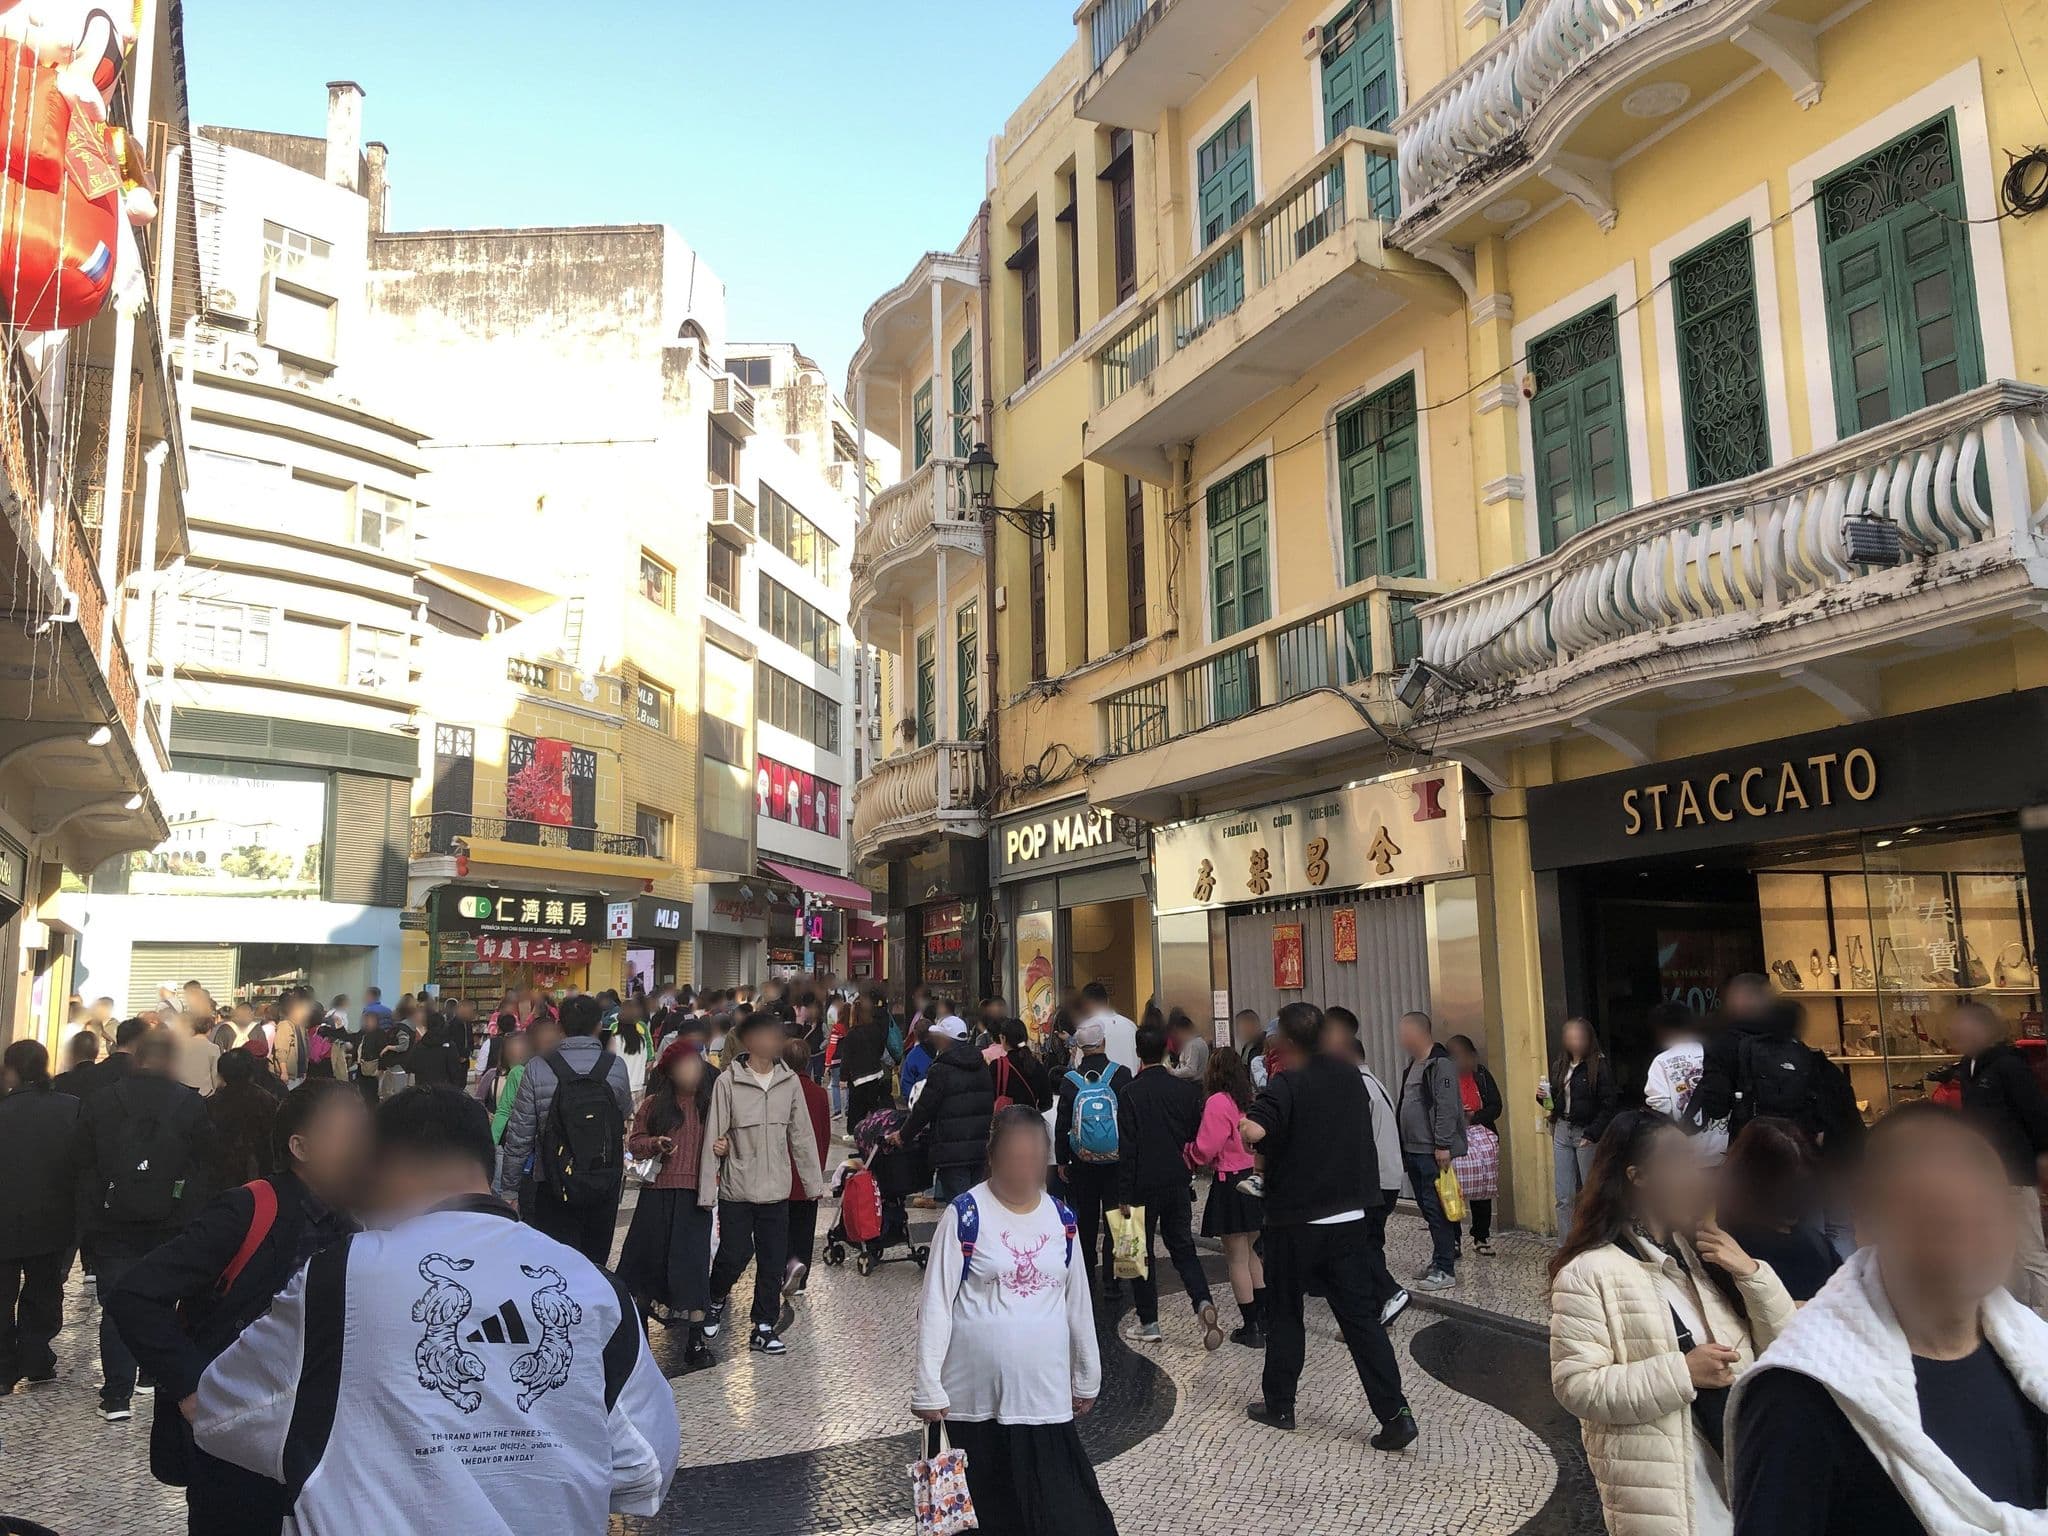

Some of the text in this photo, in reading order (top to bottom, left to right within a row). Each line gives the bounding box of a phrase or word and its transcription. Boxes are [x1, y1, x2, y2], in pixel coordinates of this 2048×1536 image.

[1622, 748, 1876, 835] STACCATO
[1007, 807, 1114, 865] POP MART
[1222, 820, 1258, 839] FARMÁCIA
[495, 896, 588, 926] 仁濟藥房
[655, 908, 680, 929] MLB
[473, 1431, 492, 1439] WITH
[493, 1430, 508, 1438] THE
[504, 1454, 535, 1462] ANYDAY
